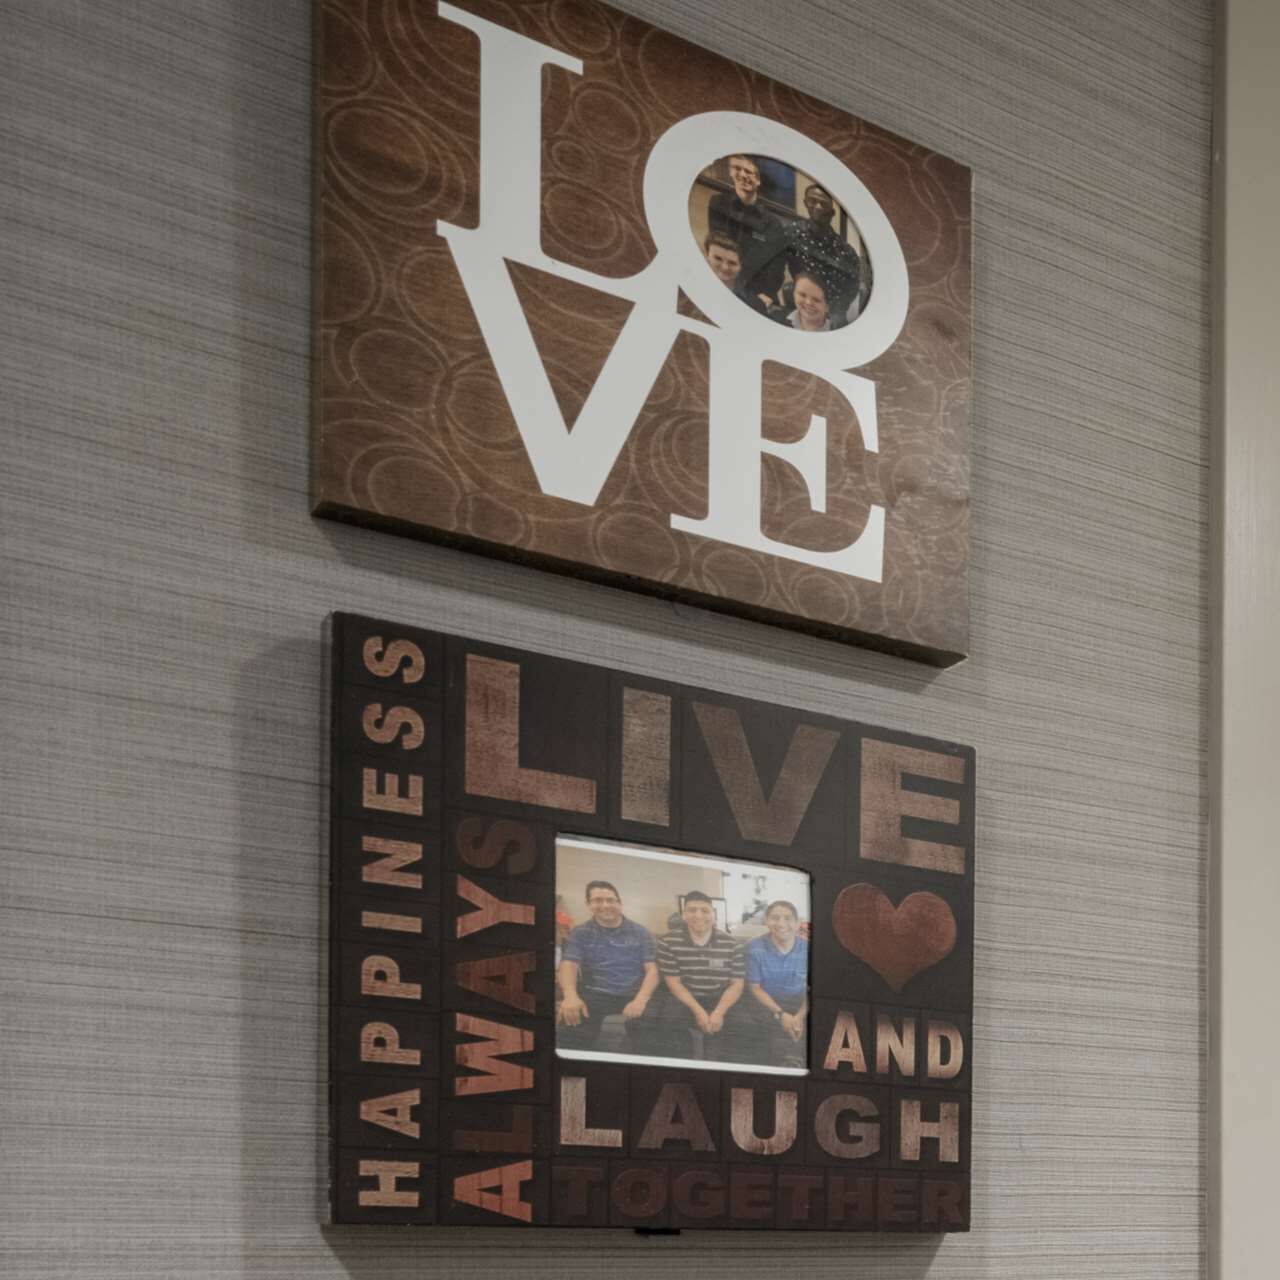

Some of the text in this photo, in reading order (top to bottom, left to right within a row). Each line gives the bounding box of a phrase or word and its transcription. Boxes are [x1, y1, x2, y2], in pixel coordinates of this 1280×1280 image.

[465, 654, 966, 875] LIVE
[359, 635, 426, 1207] HAPPINESS
[454, 815, 537, 1222] ALWAYS
[823, 1010, 964, 1079] AND
[556, 1165, 966, 1224] TOGETHER
[559, 1076, 959, 1163] LAUGH
